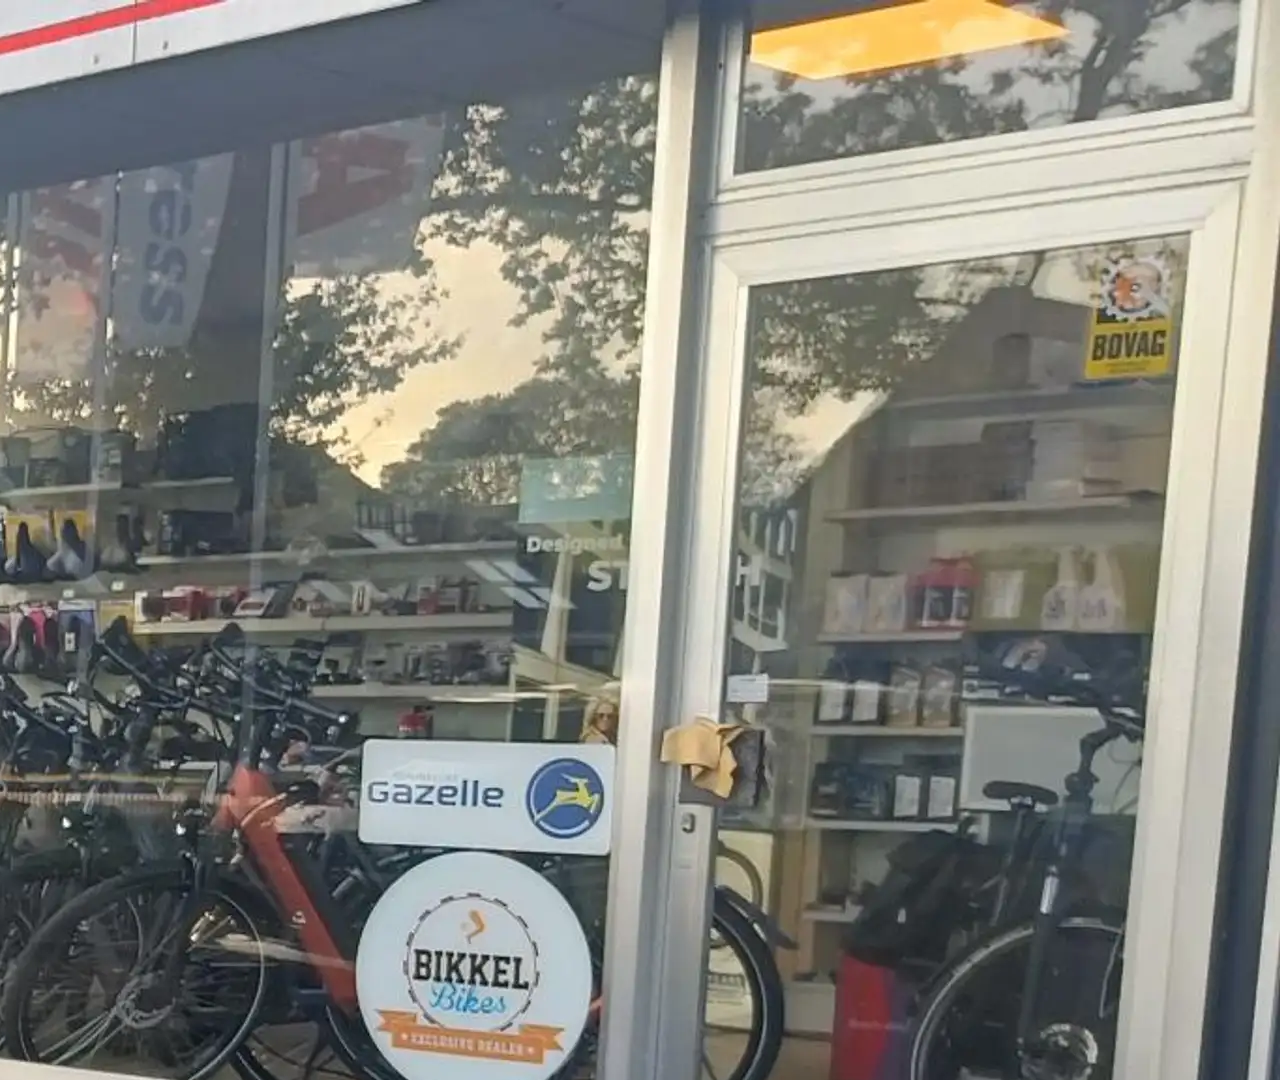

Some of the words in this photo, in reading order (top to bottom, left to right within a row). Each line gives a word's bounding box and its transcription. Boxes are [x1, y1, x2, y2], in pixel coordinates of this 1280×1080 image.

[1092, 330, 1167, 361] BOVAG
[526, 533, 623, 555] Designed
[368, 780, 504, 808] Gazelle
[413, 949, 529, 990] BIKKEL
[429, 983, 507, 1014] Bikes
